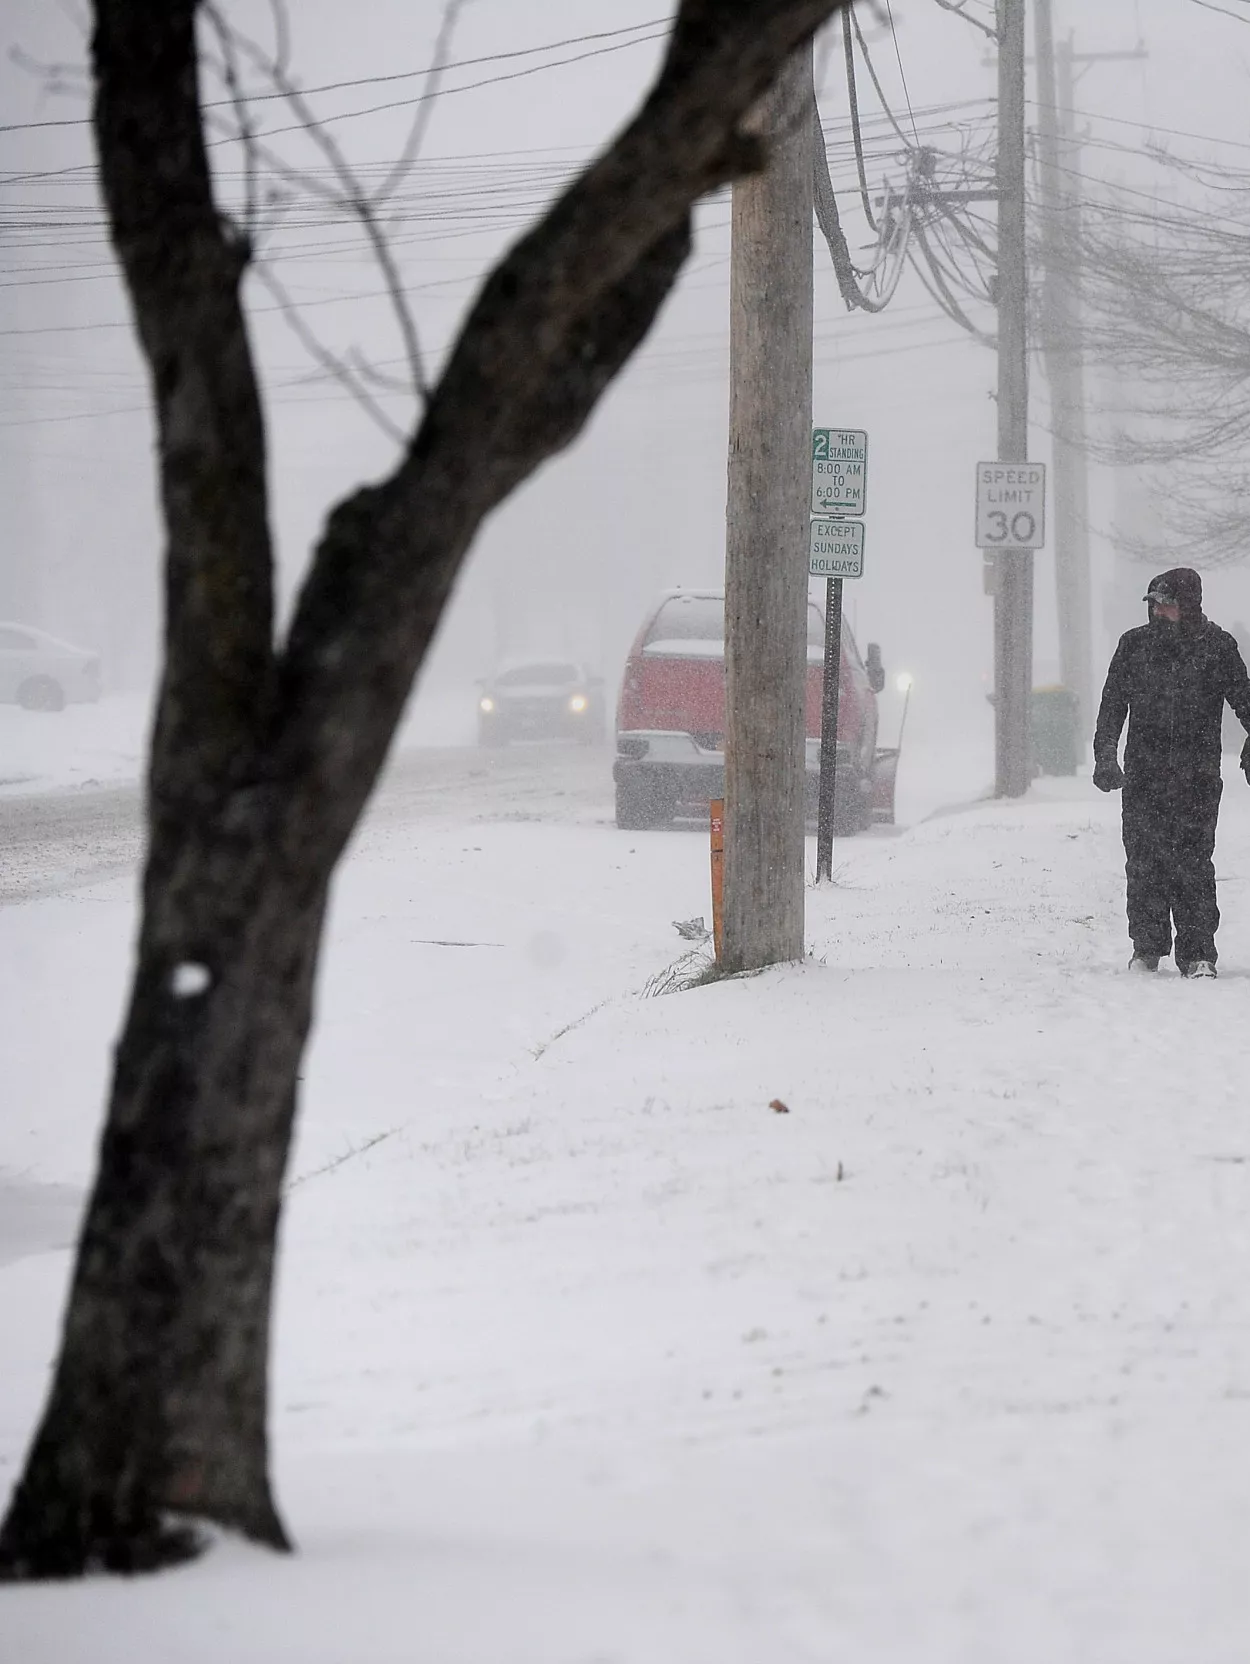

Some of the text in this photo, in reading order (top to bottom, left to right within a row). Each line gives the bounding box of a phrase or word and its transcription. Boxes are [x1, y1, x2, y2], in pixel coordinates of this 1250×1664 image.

[814, 434, 828, 456] 2
[840, 434, 856, 446] HR
[829, 447, 864, 460] STANDING
[817, 463, 861, 476] 8:00 AM
[832, 475, 845, 486] TO
[983, 470, 1039, 484] SPEED
[816, 486, 861, 499] 6:00 PM
[987, 488, 1034, 503] LIMIT
[817, 524, 856, 538] EXCEPT
[984, 510, 1036, 543] 30
[813, 541, 859, 555] SUNDAYS
[811, 558, 859, 573] HOLIDAYS
